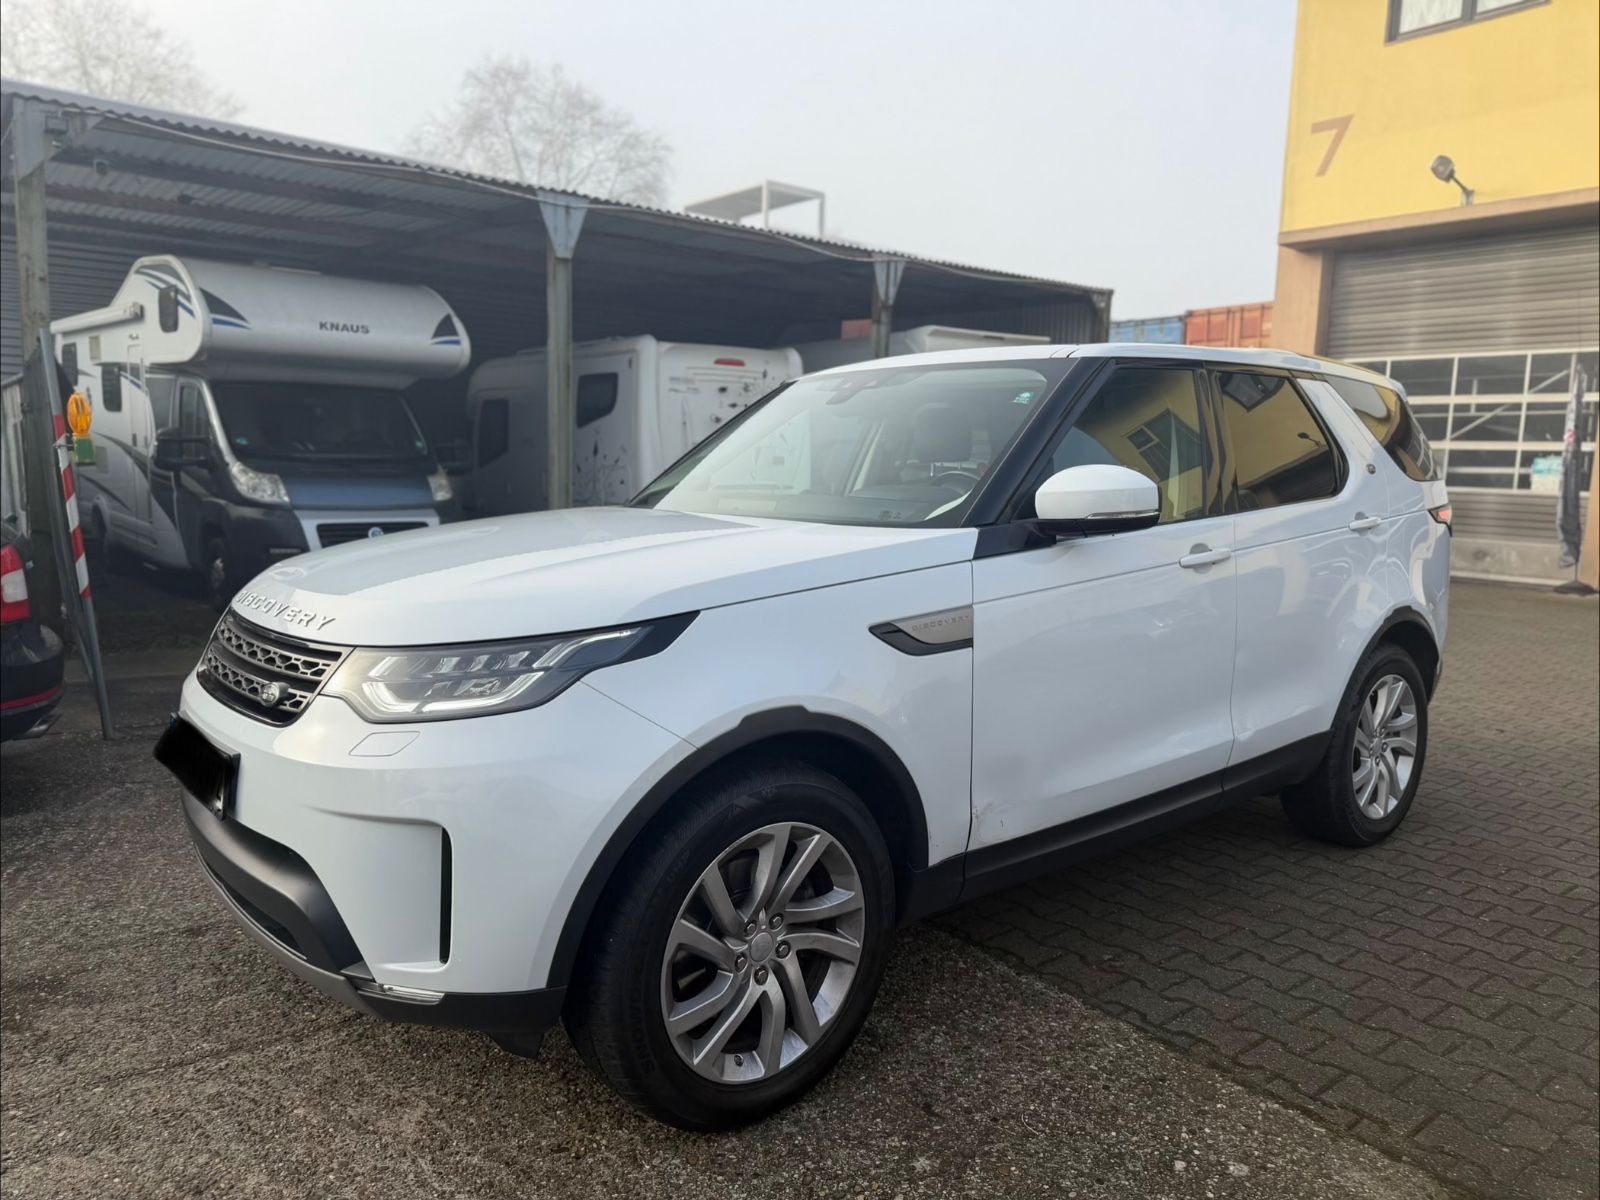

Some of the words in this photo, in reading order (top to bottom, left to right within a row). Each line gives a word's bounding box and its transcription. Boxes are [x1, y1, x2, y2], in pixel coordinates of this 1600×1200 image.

[1311, 113, 1355, 177] 7
[319, 321, 370, 335] KNAUS
[236, 590, 336, 630] DISCOVERY
